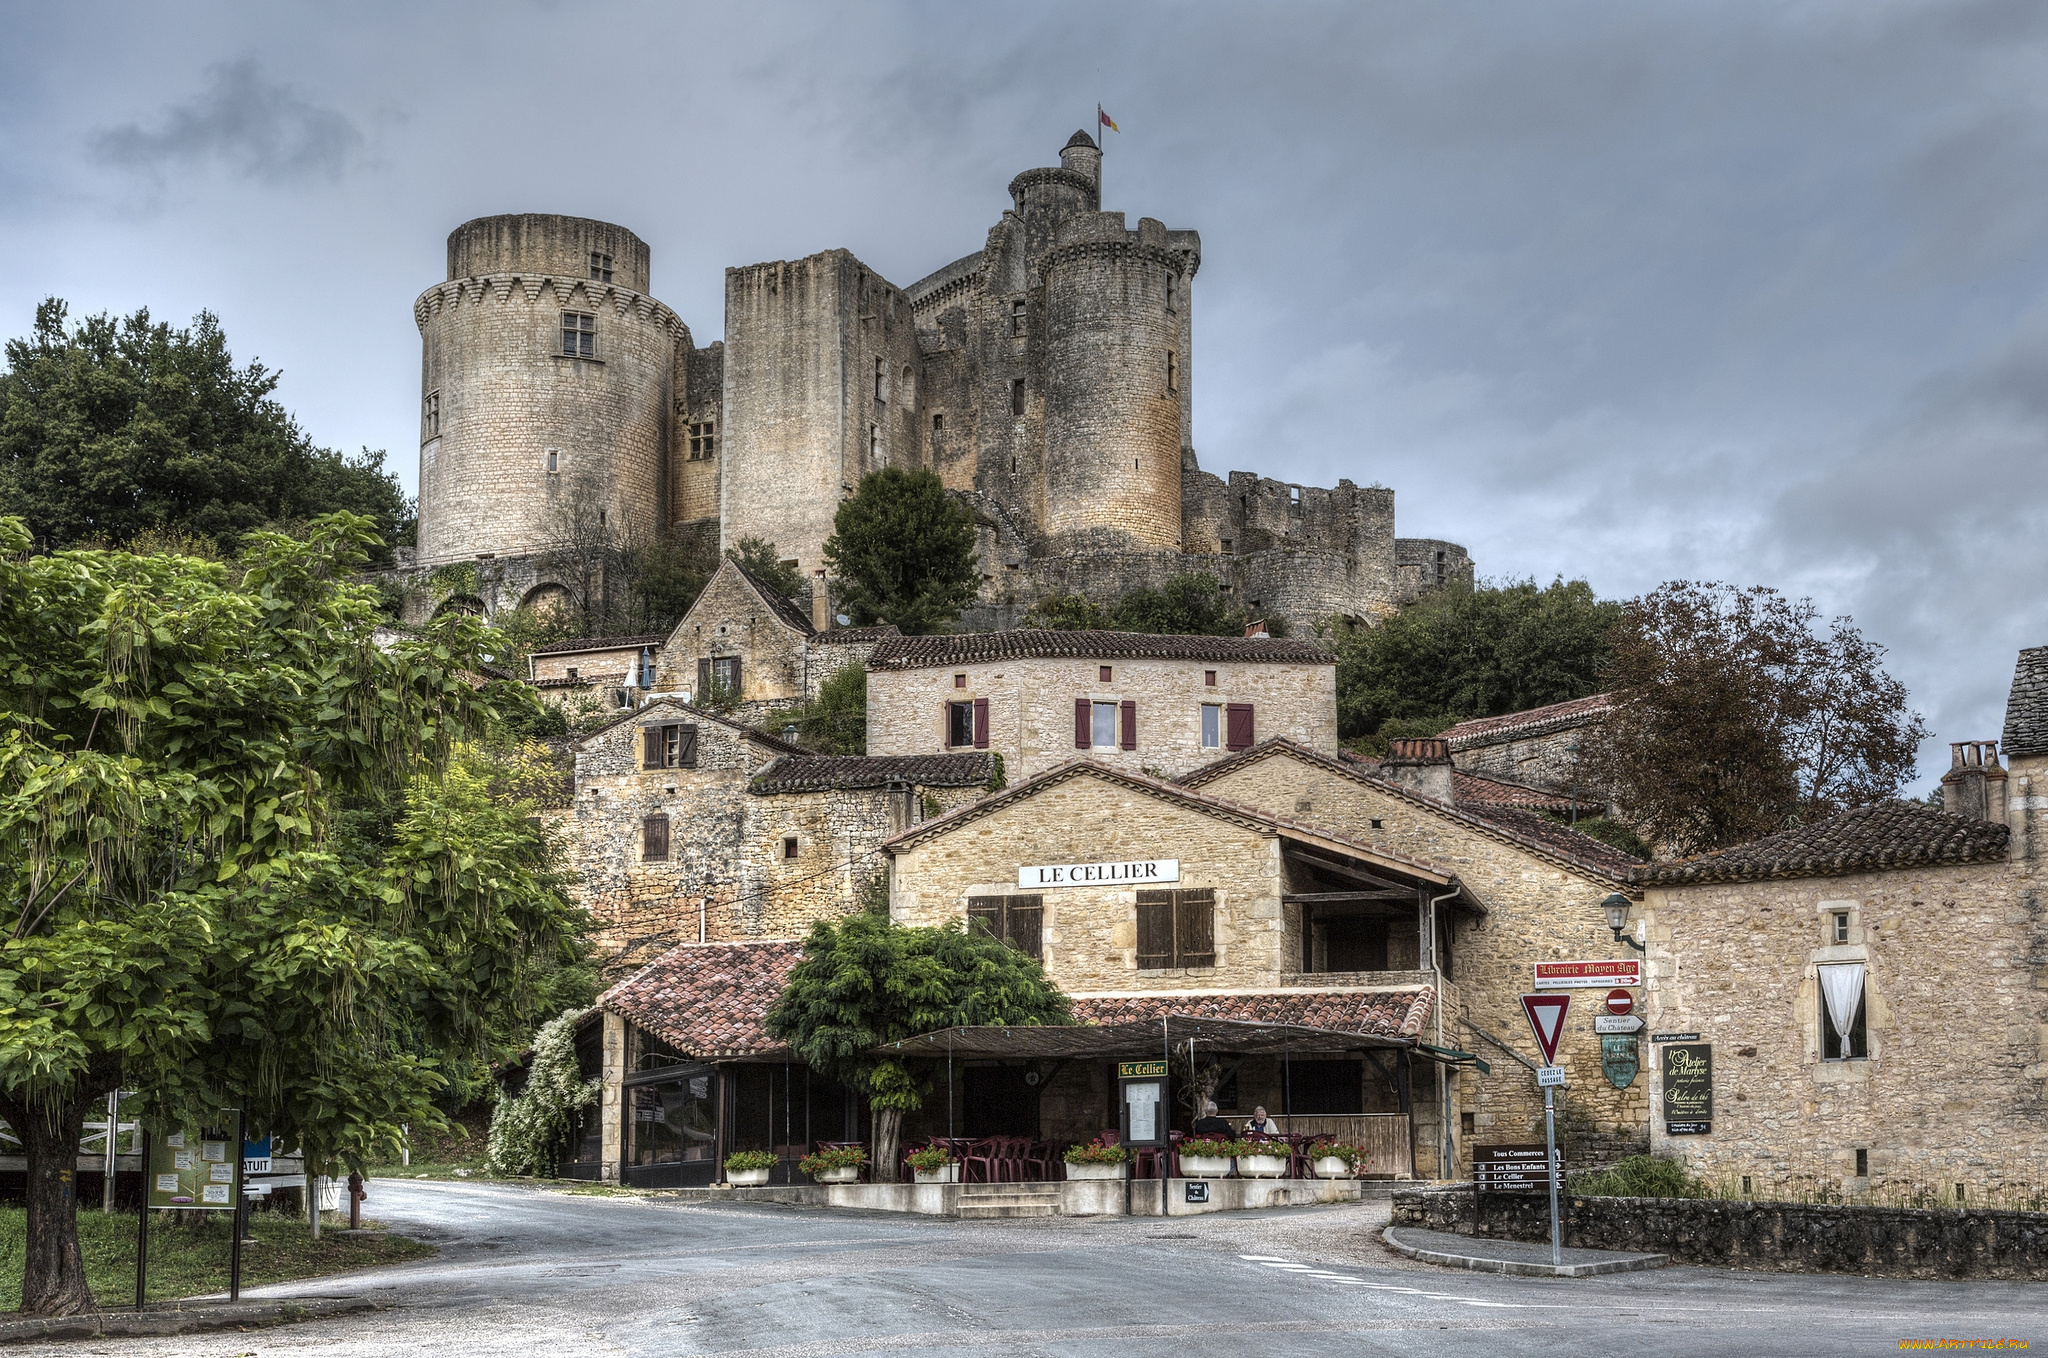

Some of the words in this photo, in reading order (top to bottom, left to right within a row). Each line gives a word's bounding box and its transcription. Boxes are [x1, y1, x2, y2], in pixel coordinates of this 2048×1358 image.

[1038, 868, 1064, 883] LE
[1070, 862, 1158, 882] CELLIER
[1540, 964, 1579, 974] Librairie
[1583, 964, 1614, 975] Moyen
[1121, 1064, 1133, 1075] Le
[1135, 1064, 1164, 1075] Cellier
[1669, 1066, 1678, 1075] de
[1691, 1090, 1700, 1100] de
